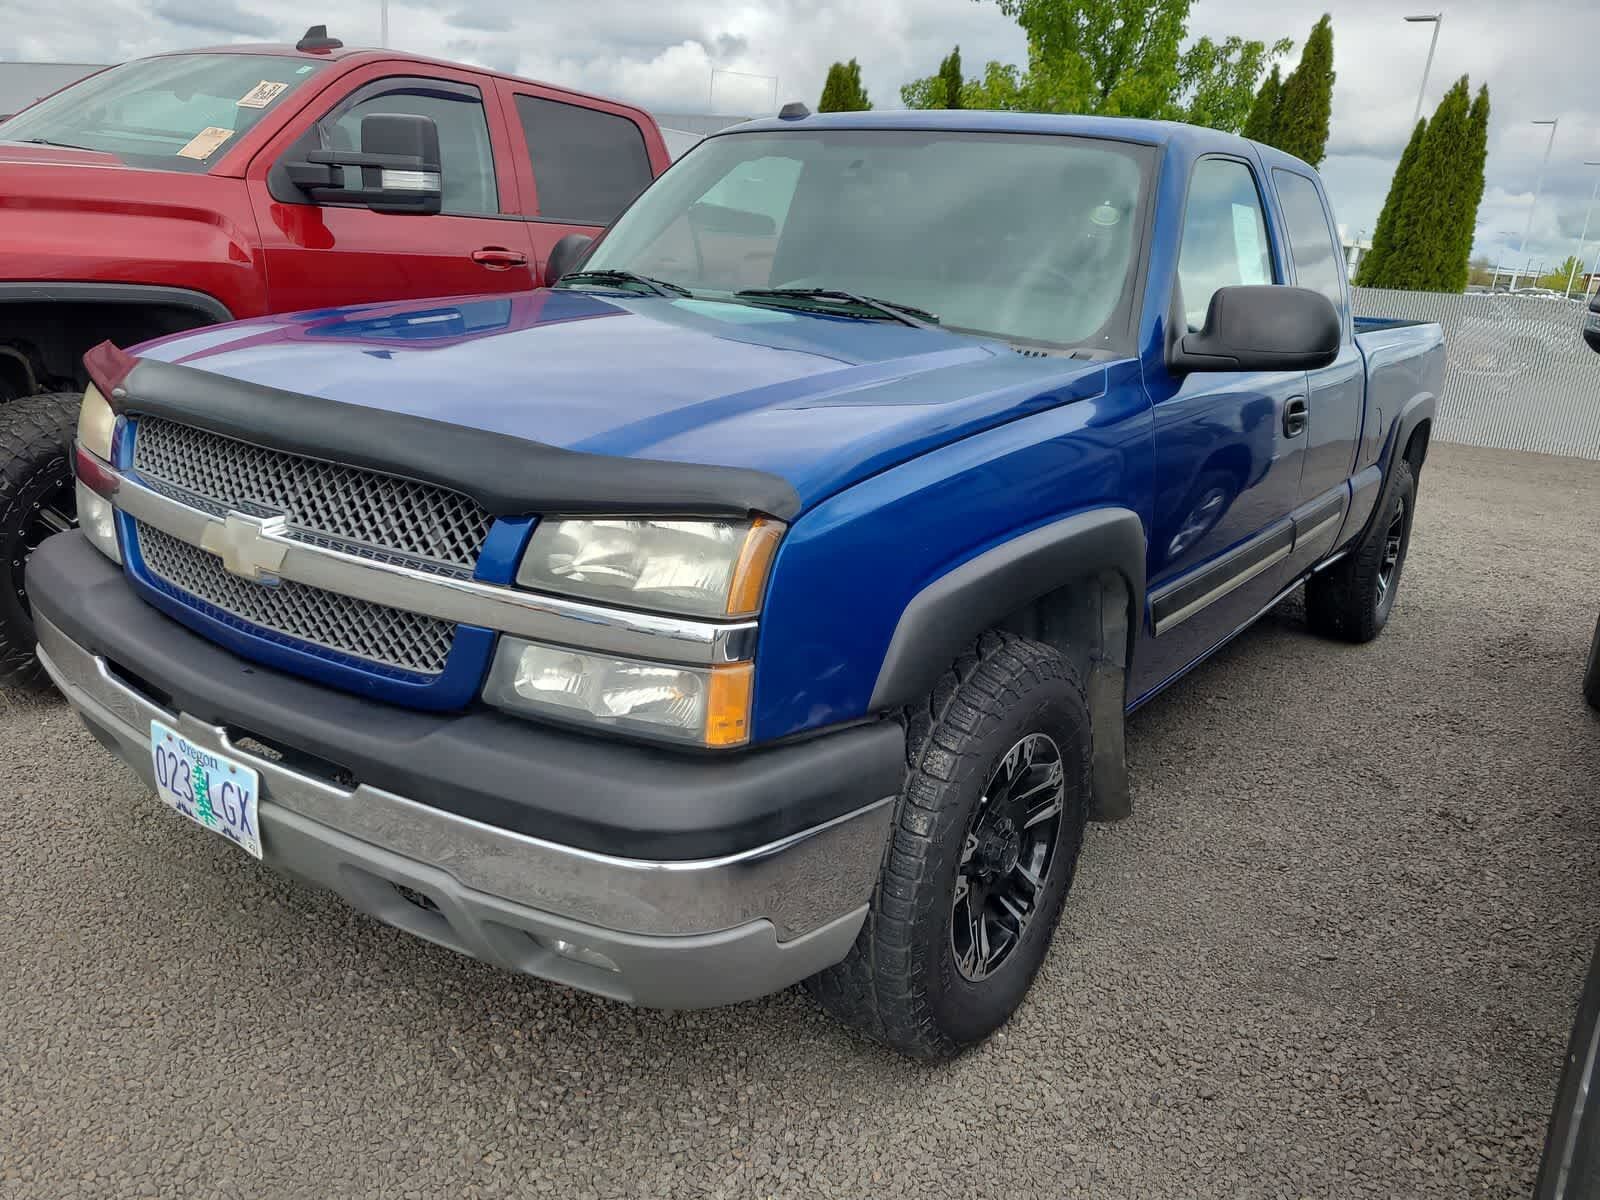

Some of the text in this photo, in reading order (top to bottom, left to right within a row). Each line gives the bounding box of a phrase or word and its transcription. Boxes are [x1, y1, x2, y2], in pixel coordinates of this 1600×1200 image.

[178, 739, 219, 770] Oregon
[156, 745, 252, 836] 023 LGX
